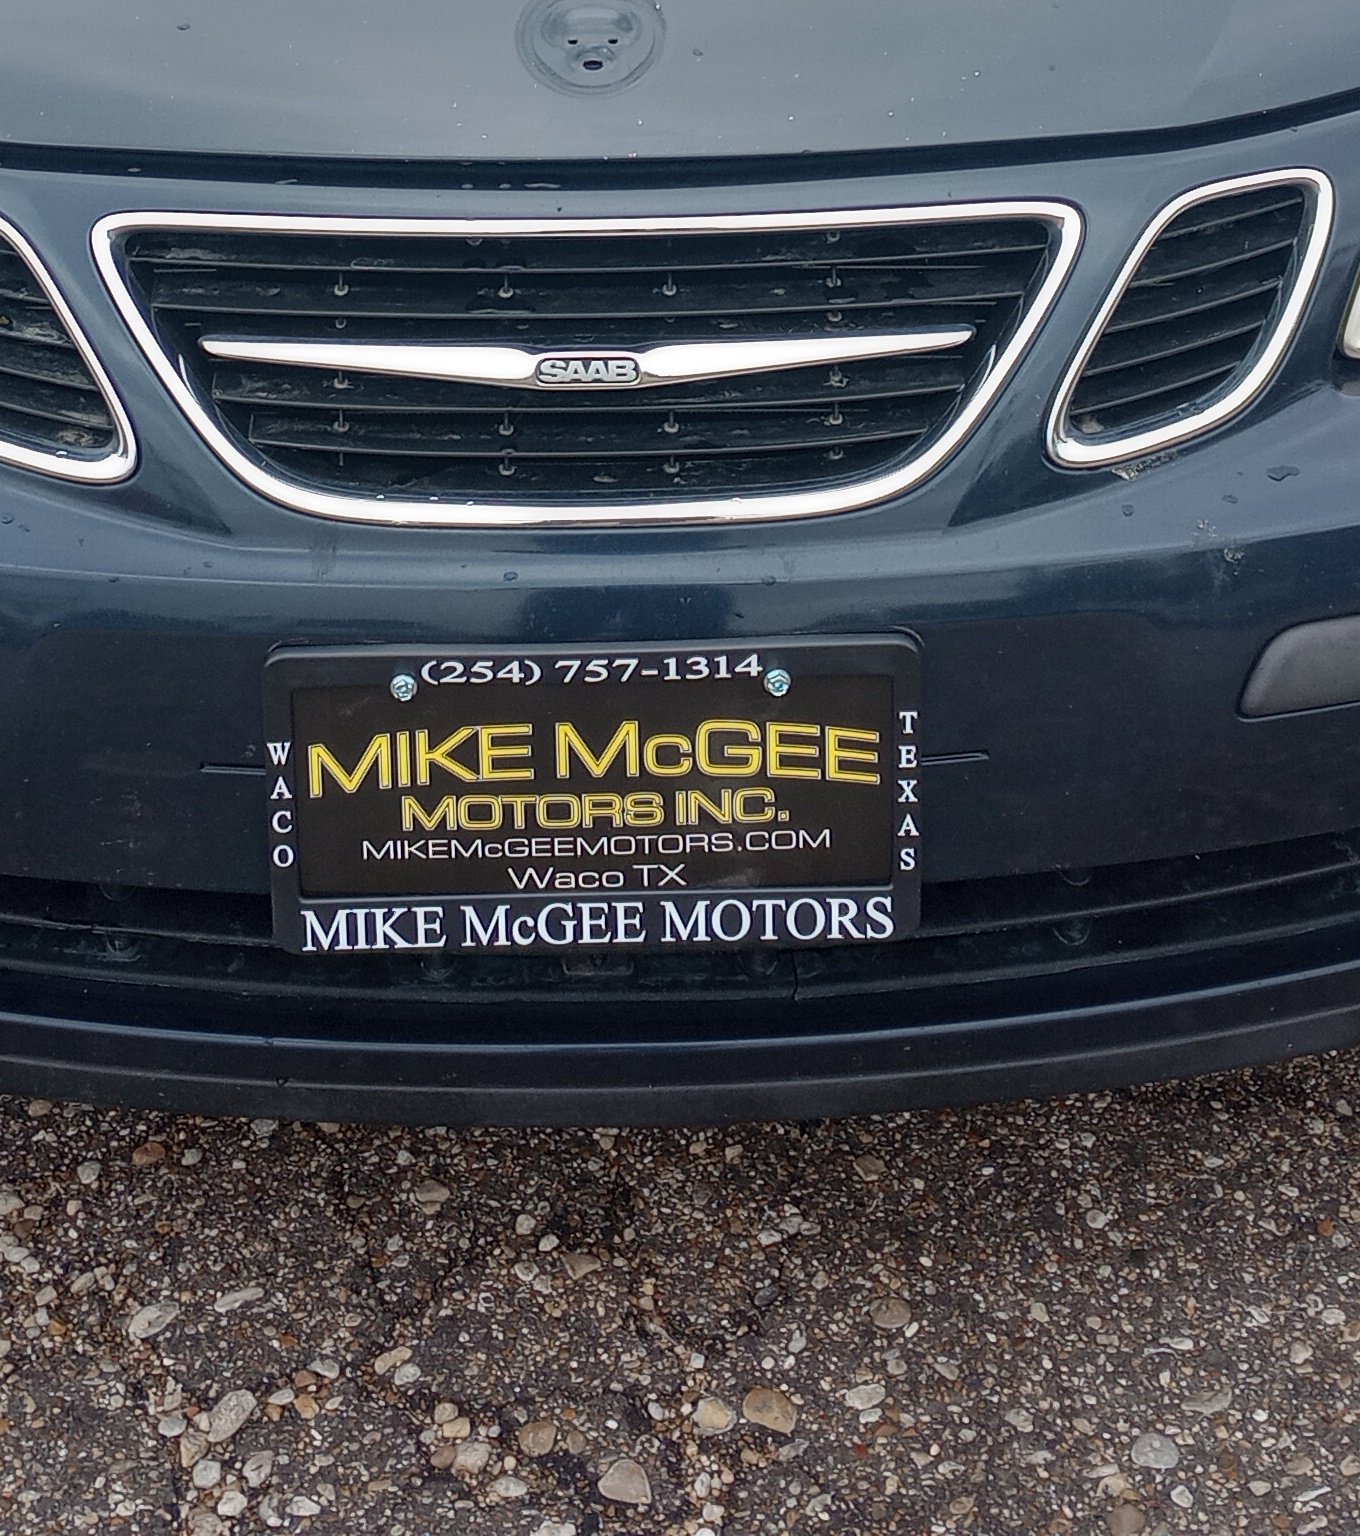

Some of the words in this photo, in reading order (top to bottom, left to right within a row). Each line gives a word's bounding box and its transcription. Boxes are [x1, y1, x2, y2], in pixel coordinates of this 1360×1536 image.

[539, 359, 638, 382] SAAB
[421, 659, 542, 686] (254)
[554, 654, 764, 683] 757-1314
[307, 723, 535, 799] MIKE
[555, 719, 881, 785] McGEE
[266, 741, 295, 867] WACO
[401, 792, 664, 832] MOTORS
[675, 787, 791, 826] INC.
[897, 711, 920, 871] TEXAS
[362, 828, 831, 860] MIKEMcGEEMOTORS.COM
[507, 866, 625, 889] Waco
[632, 863, 687, 888] TX
[300, 906, 447, 952] MIKE
[459, 901, 647, 947] McGEE
[660, 895, 895, 943] MOTORS
